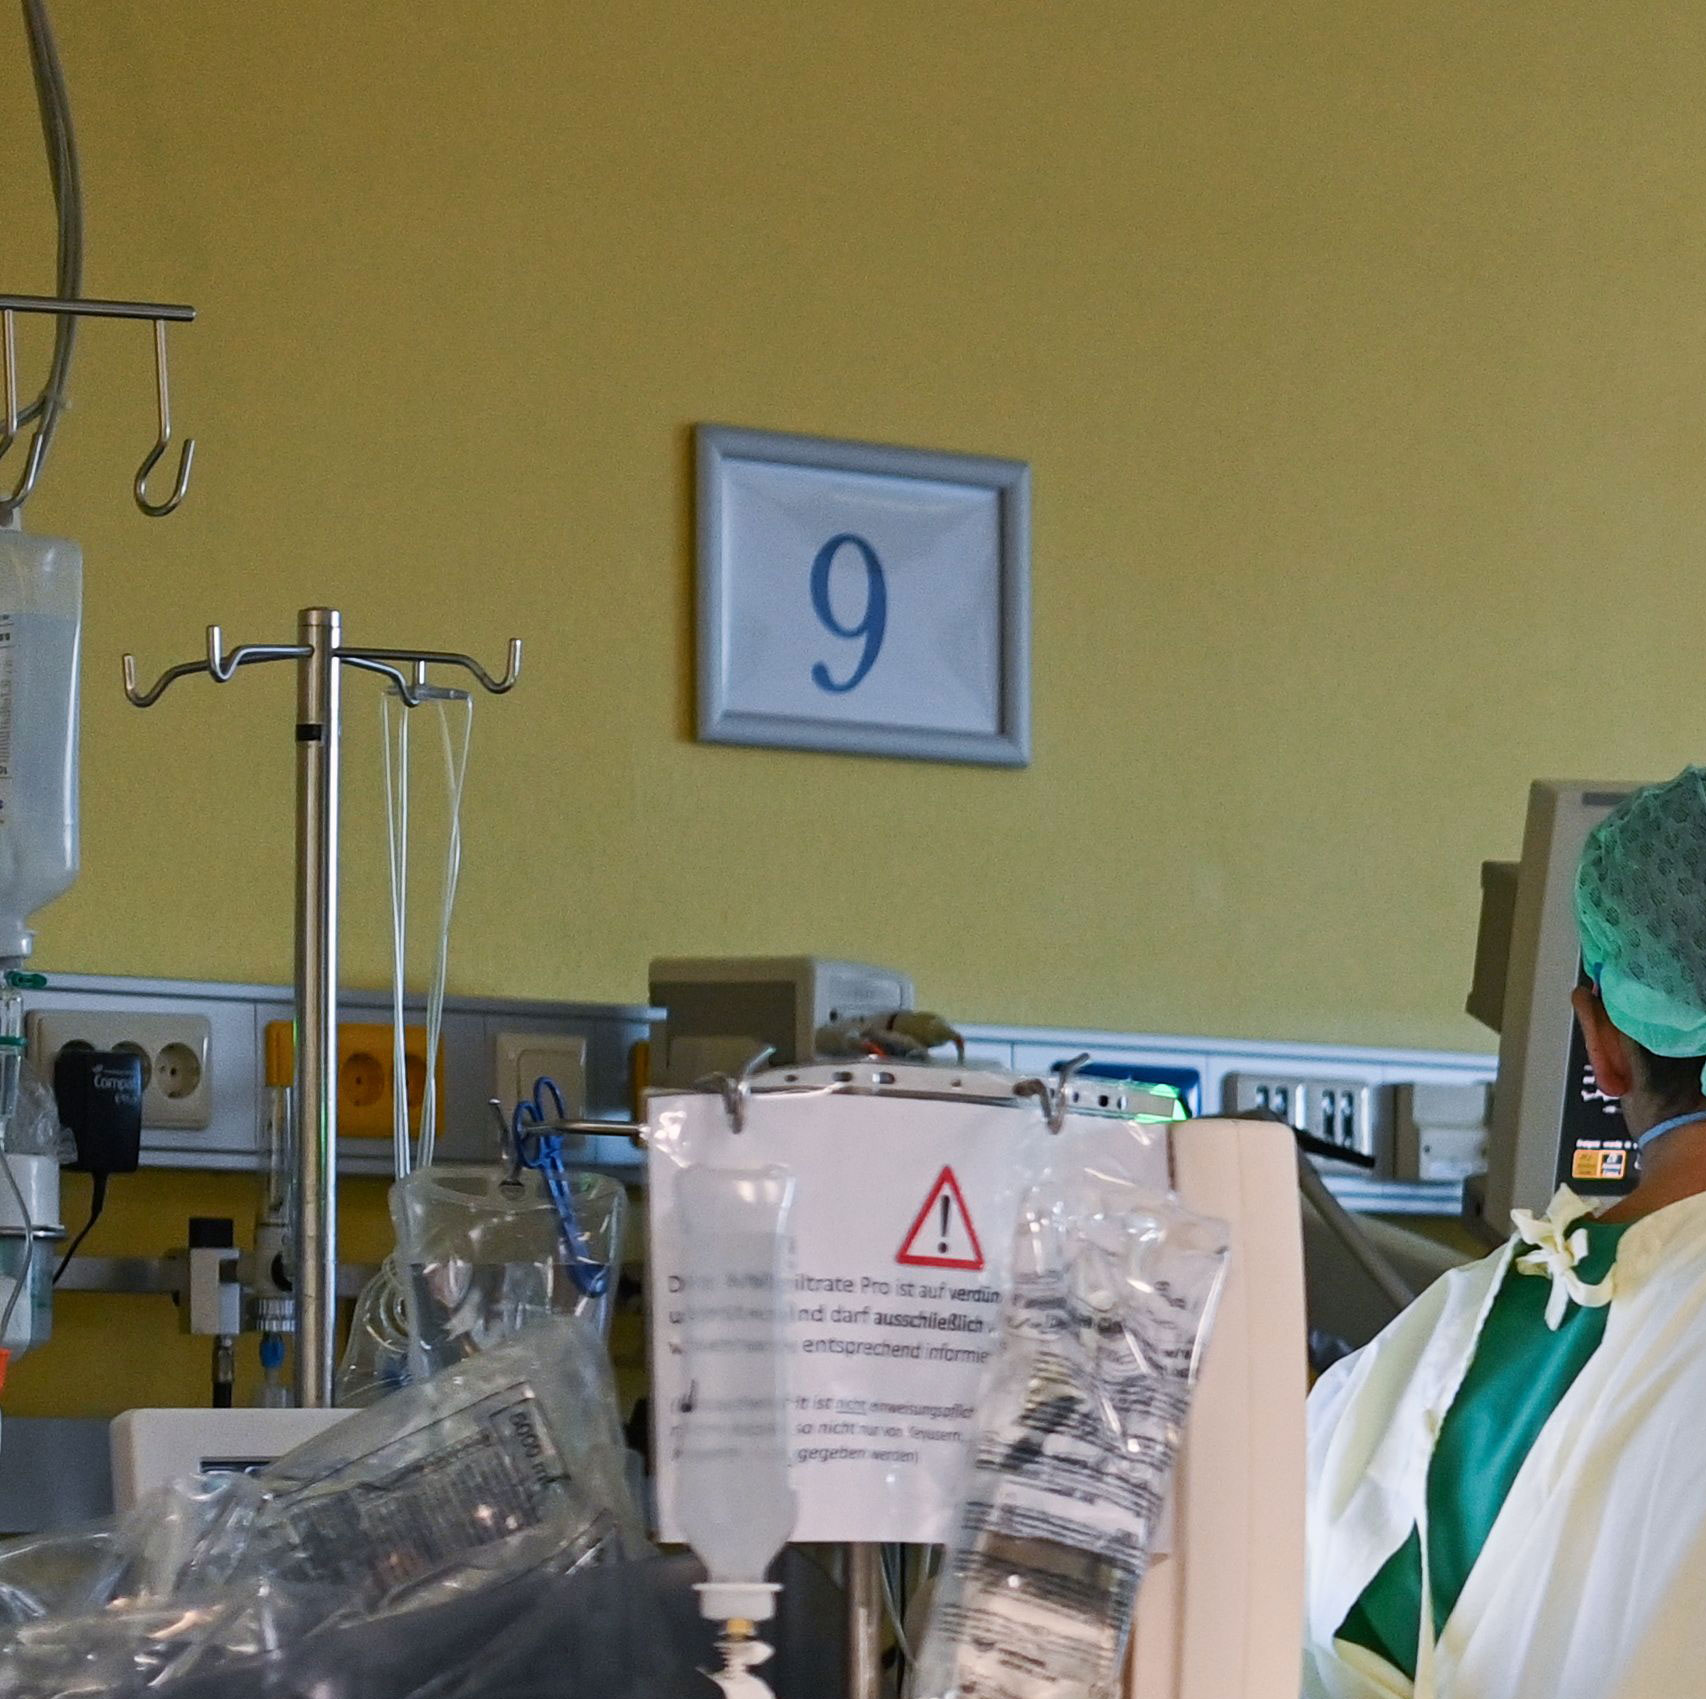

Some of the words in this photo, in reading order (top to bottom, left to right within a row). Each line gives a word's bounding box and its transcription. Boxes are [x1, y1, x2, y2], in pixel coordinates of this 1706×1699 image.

[810, 531, 887, 694] 9
[862, 1276, 891, 1296] Pro
[895, 1279, 915, 1298] ist
[918, 1281, 946, 1299] auf
[830, 1306, 870, 1325] darf
[873, 1310, 984, 1333] ausschließlich
[803, 1338, 922, 1360] entsprechend
